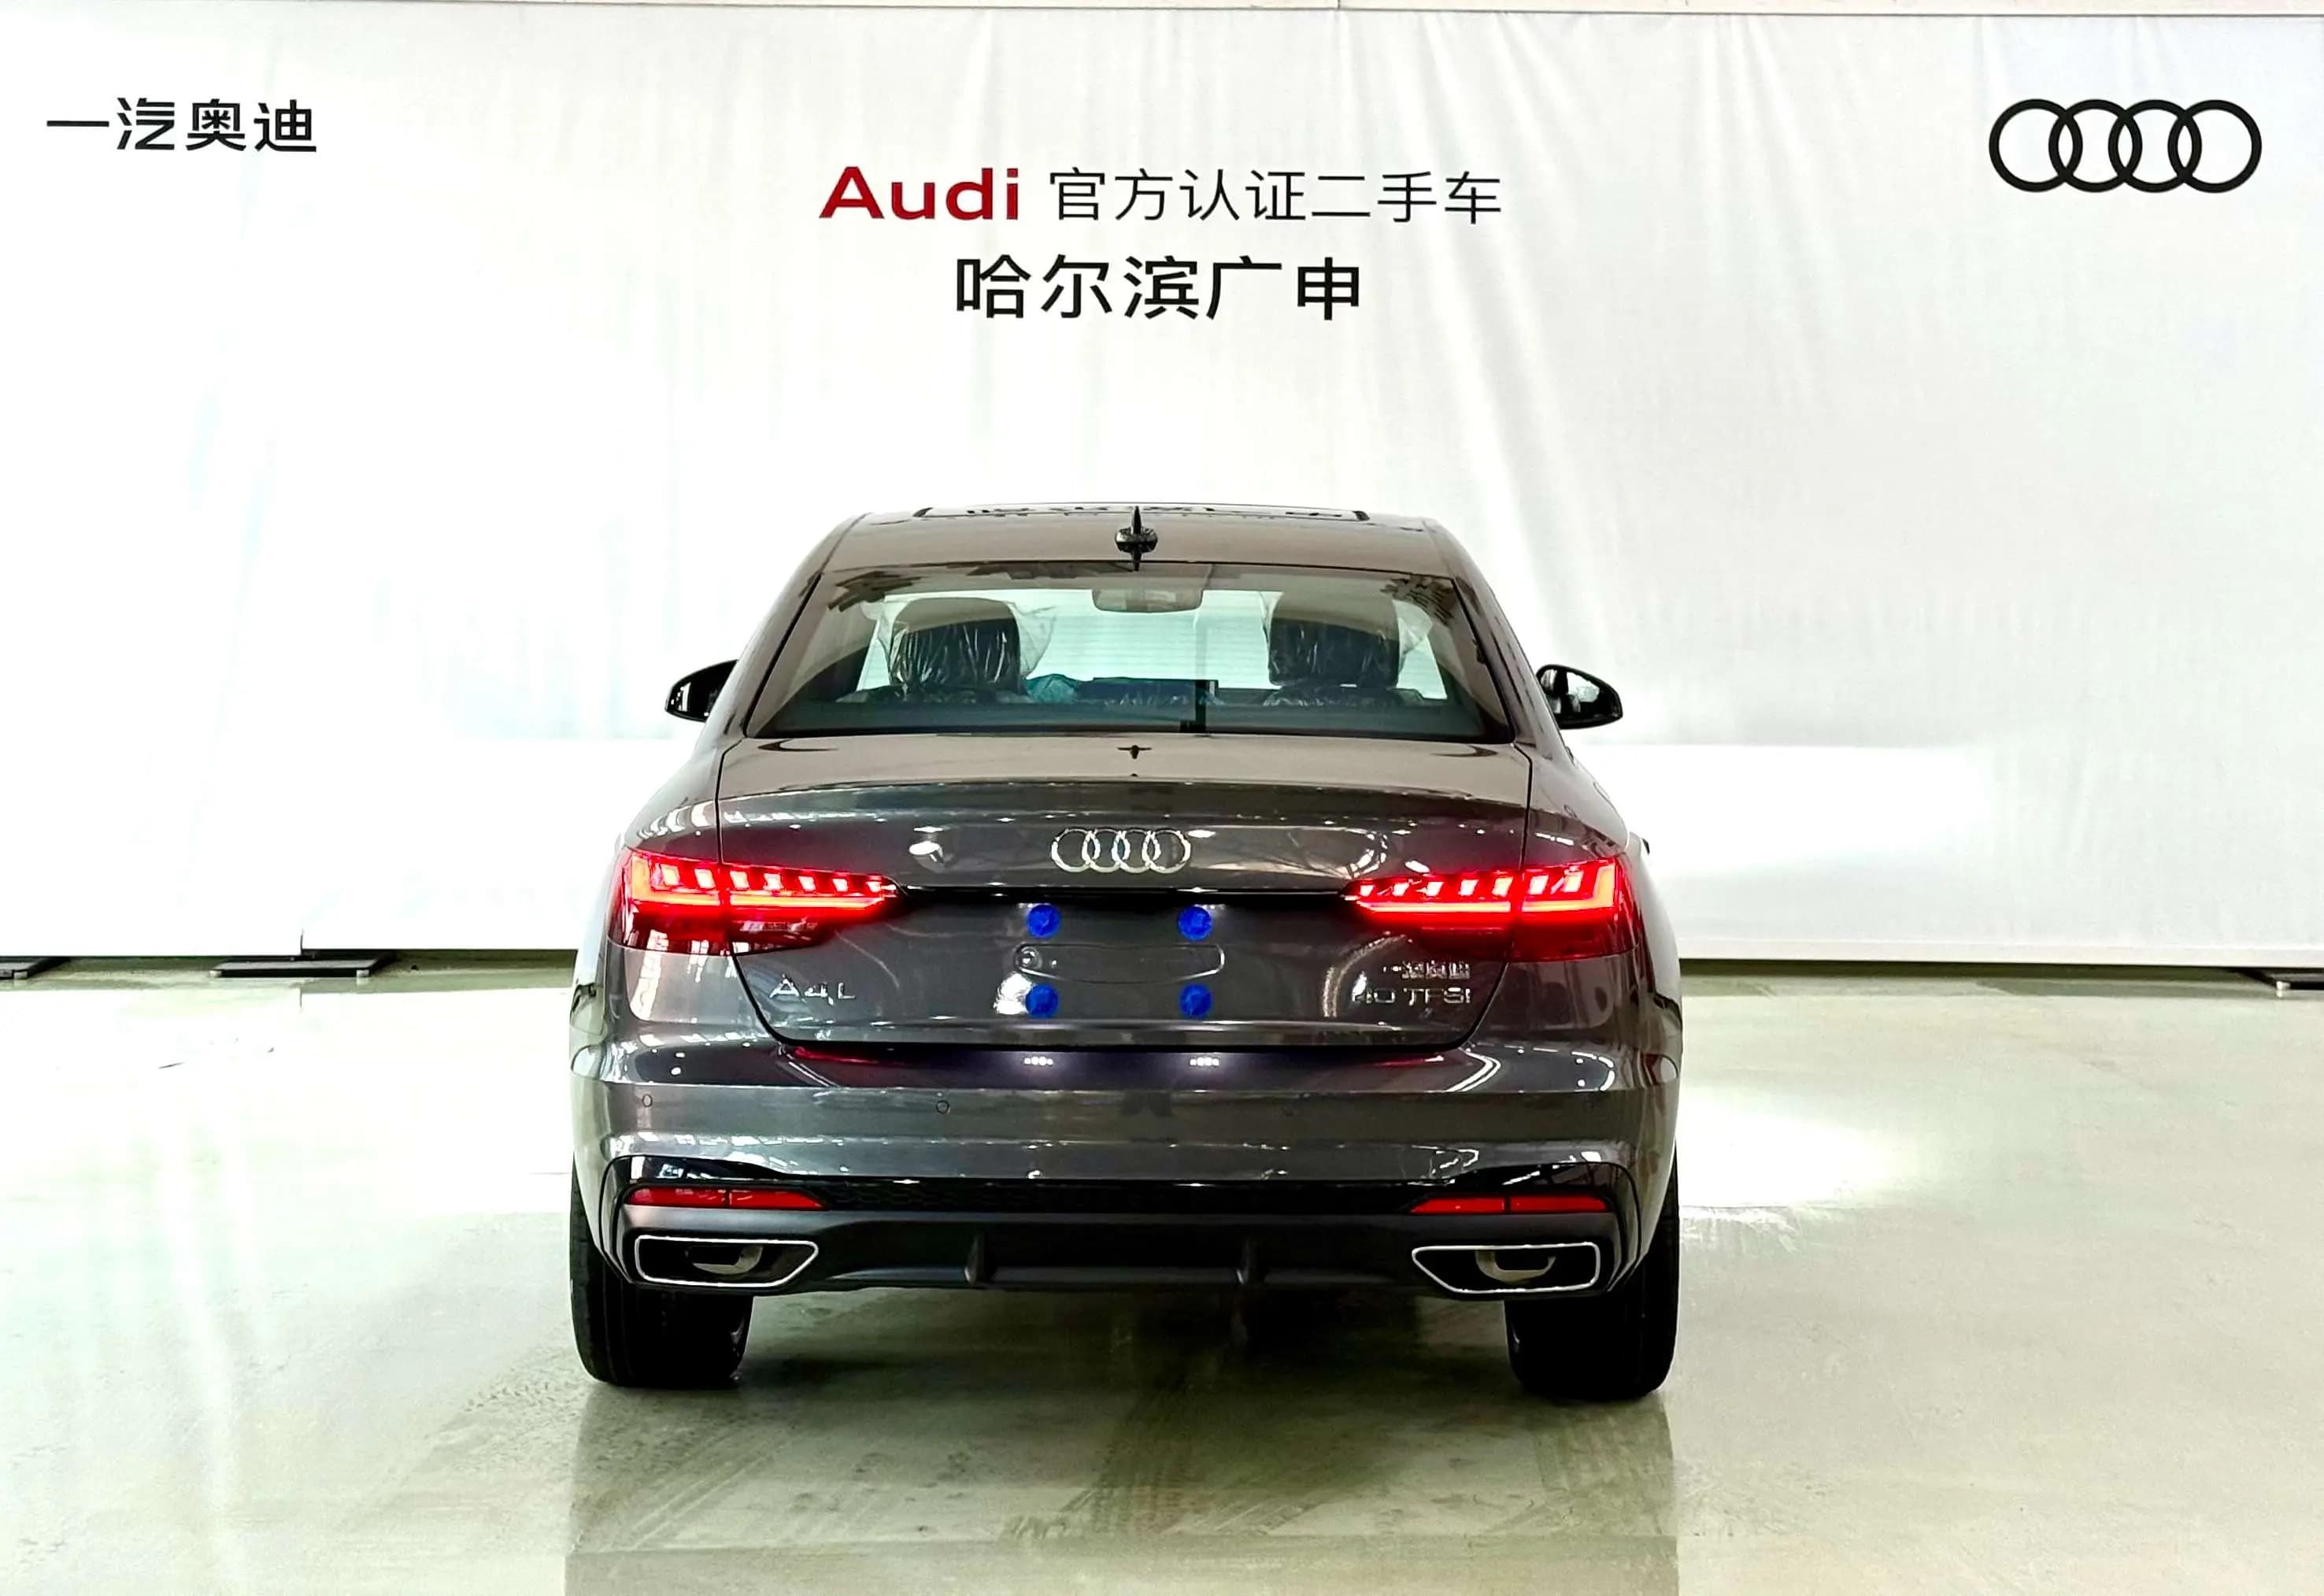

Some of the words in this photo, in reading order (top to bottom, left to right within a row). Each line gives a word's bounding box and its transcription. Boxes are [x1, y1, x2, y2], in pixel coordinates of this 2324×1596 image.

[46, 97, 317, 153] 一汽奥迪
[819, 165, 1019, 220] Audi
[1049, 166, 1502, 224] 官方认证二手车
[956, 253, 1360, 320] 哈尔滨广申
[768, 974, 857, 1005] A4L
